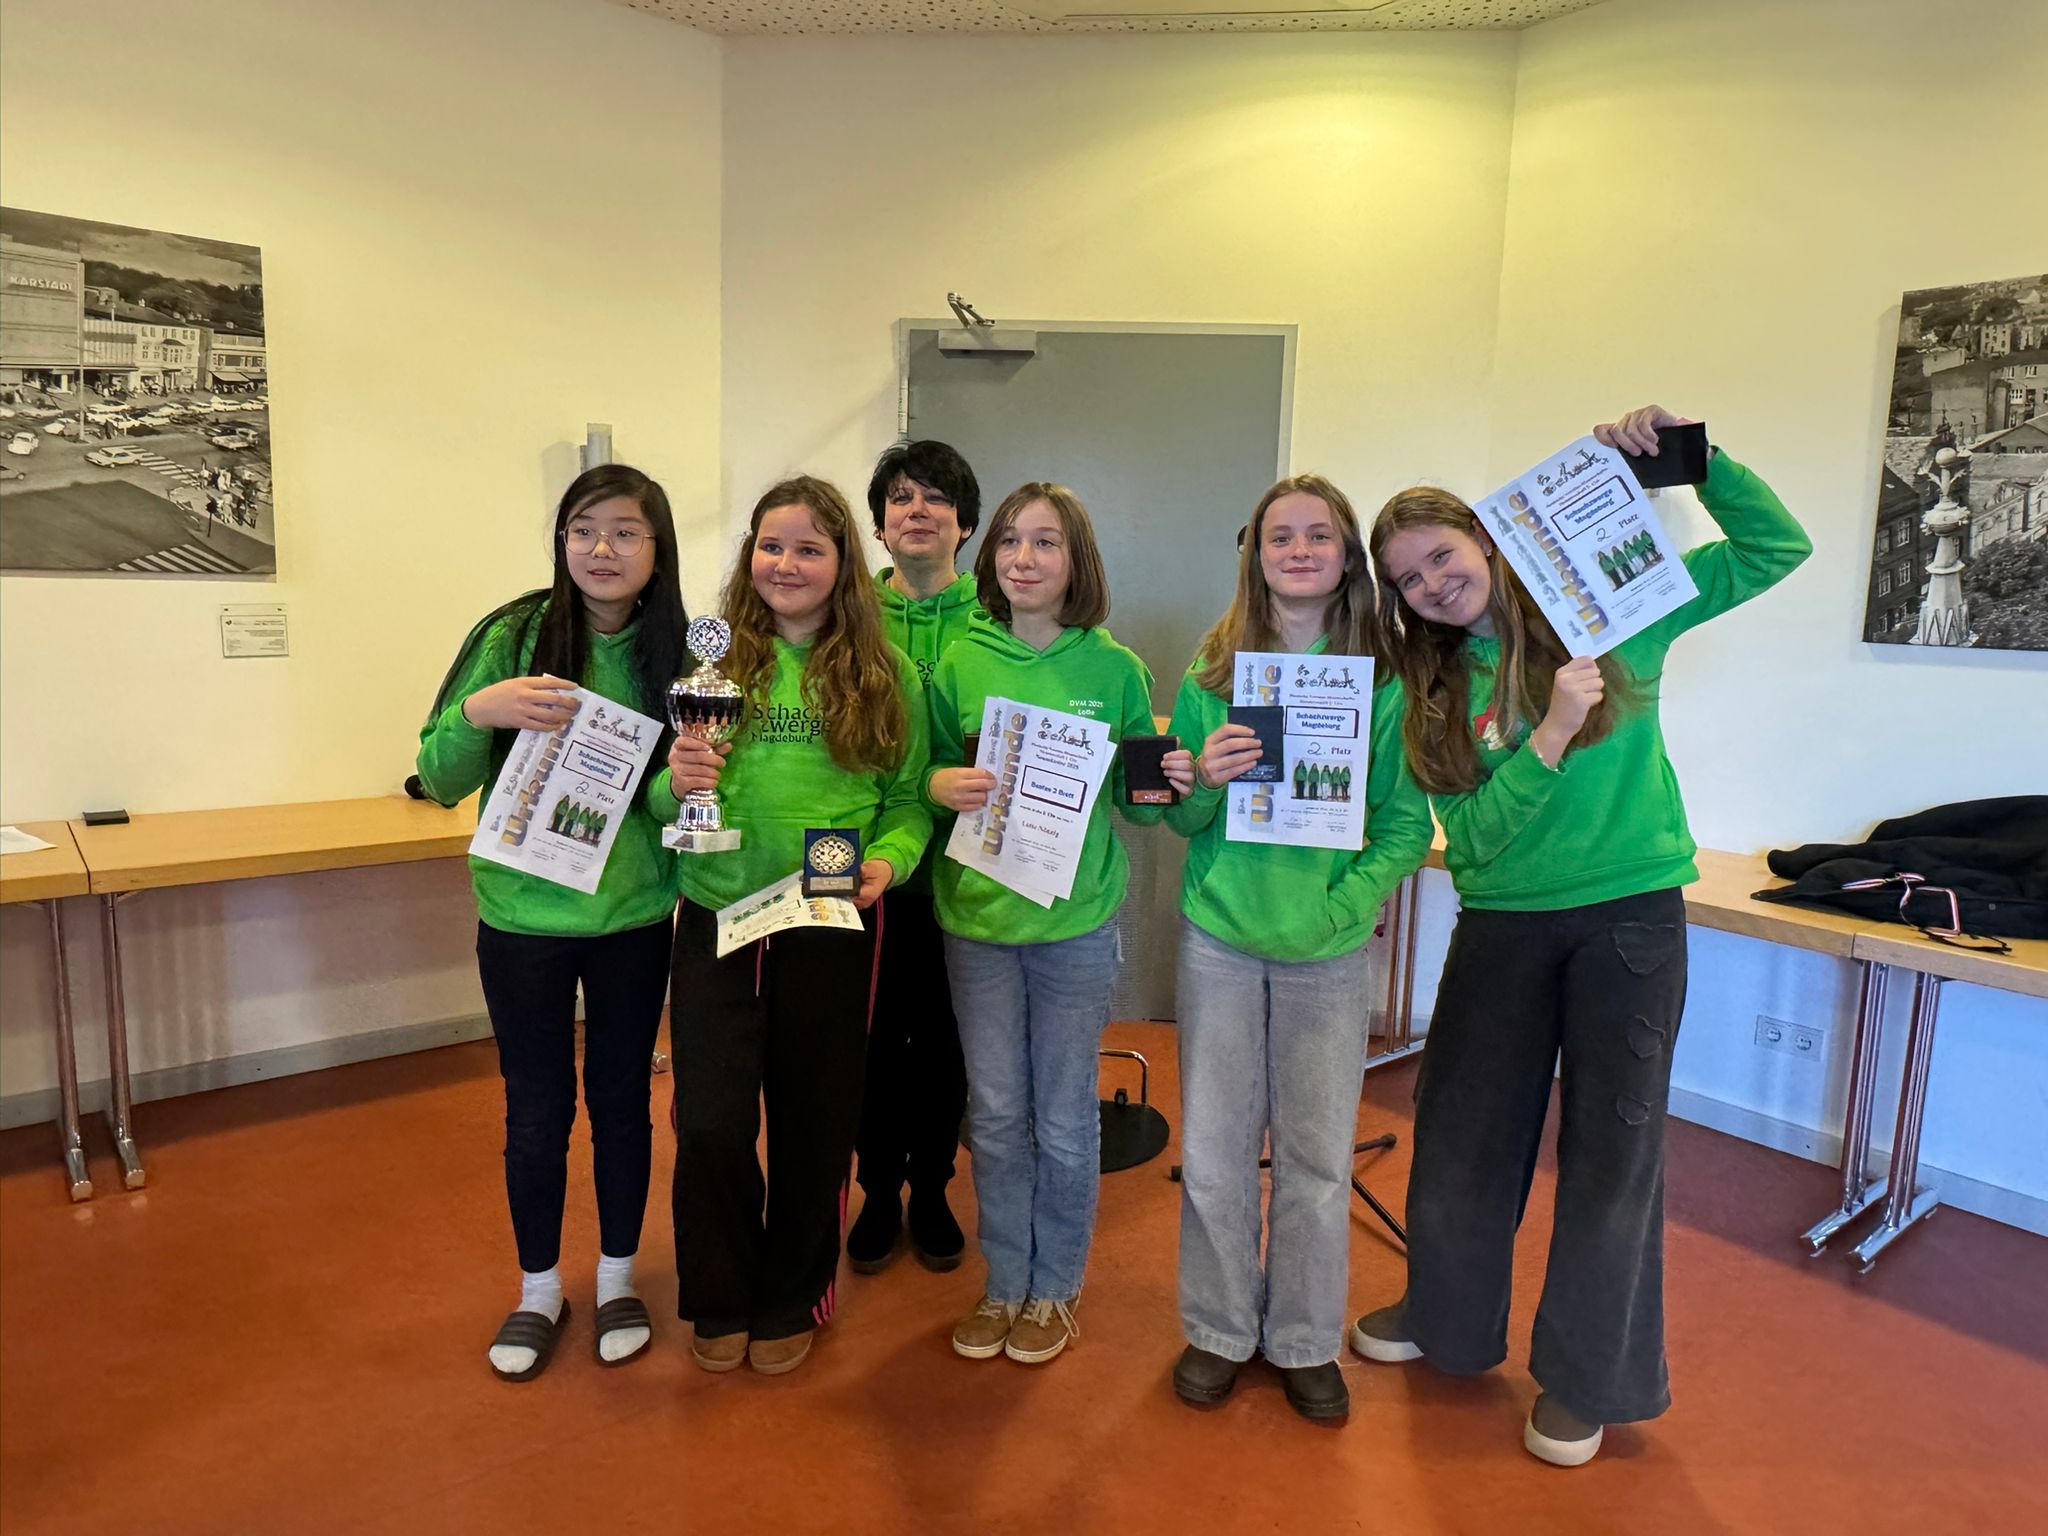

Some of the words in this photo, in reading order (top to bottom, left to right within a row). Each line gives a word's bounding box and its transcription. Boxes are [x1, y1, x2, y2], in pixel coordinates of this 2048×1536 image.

[1508, 490, 1609, 636] Urkunde
[1618, 513, 1639, 528] Platz
[982, 712, 1027, 856] Urkunde
